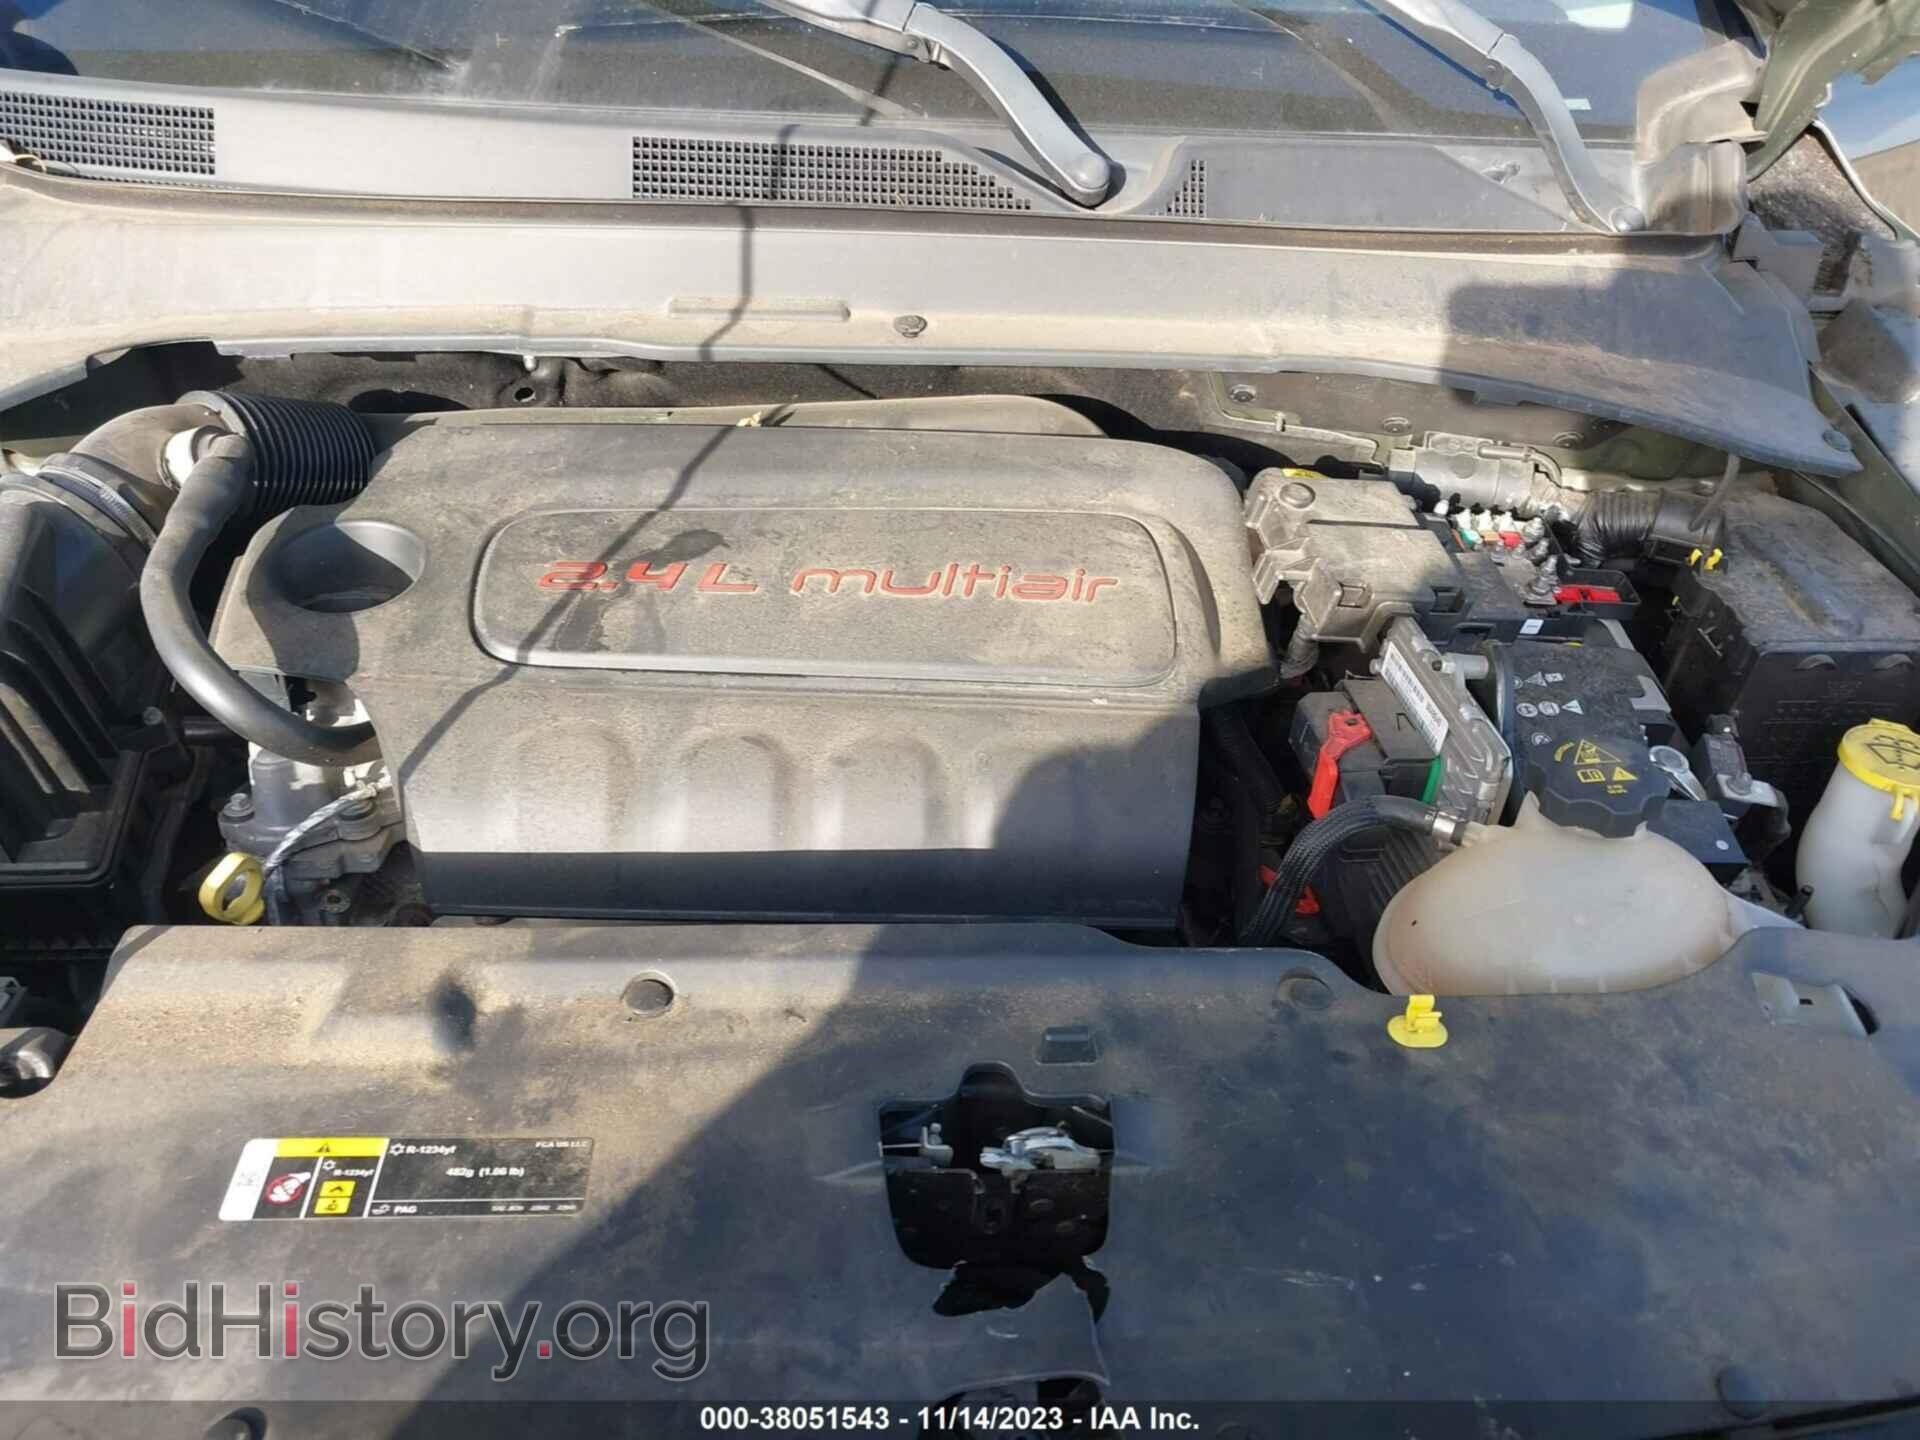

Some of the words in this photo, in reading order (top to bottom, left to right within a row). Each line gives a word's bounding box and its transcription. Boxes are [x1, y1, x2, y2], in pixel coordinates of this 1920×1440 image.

[790, 561, 1118, 603] multiair
[406, 1144, 457, 1156] R-1234yf
[393, 1204, 418, 1215] PAG
